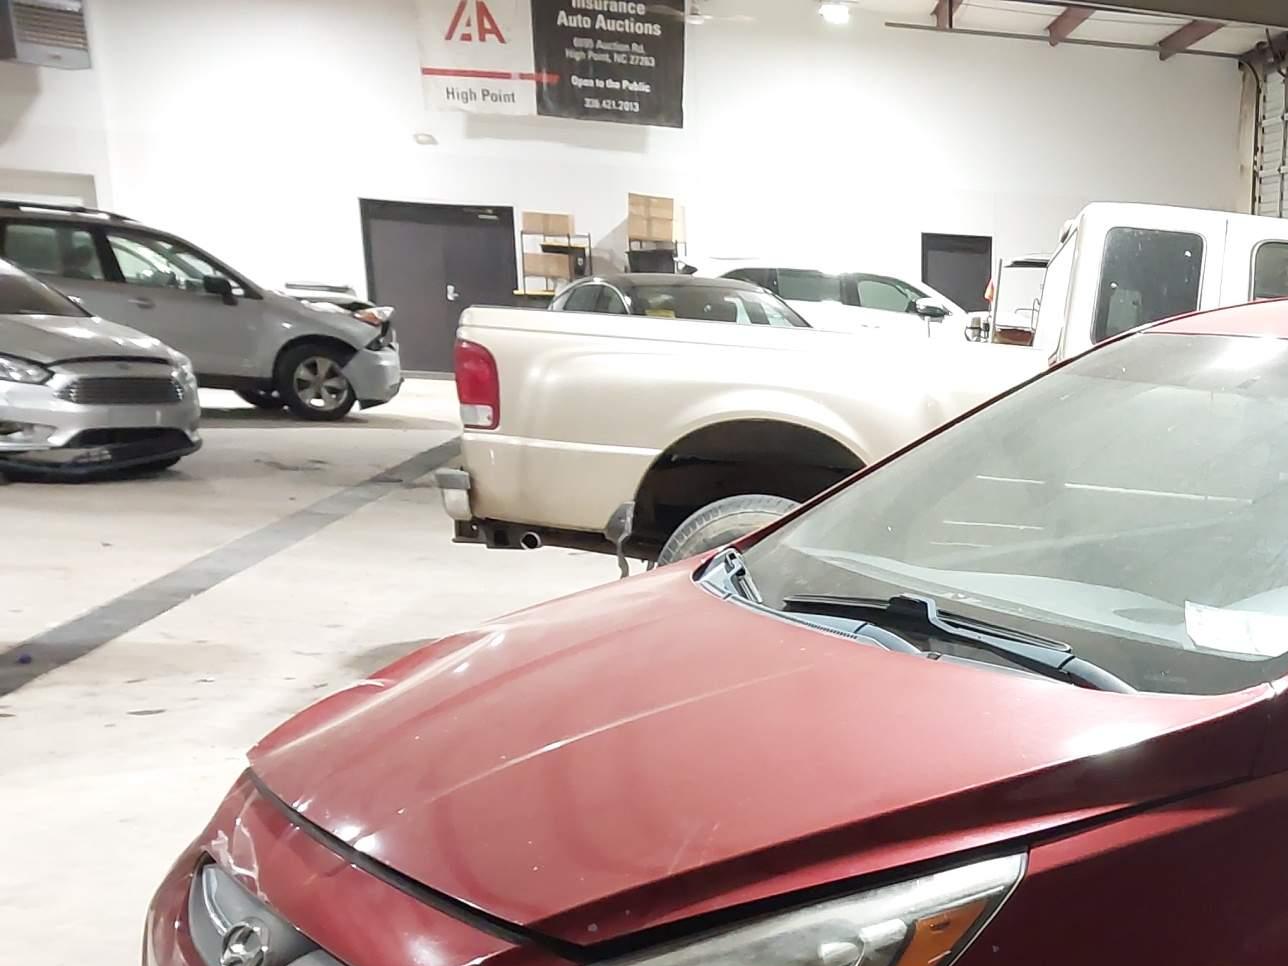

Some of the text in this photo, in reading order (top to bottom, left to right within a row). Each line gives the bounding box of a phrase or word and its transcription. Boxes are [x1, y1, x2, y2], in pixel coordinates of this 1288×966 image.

[571, 0, 646, 15] Insurance
[557, 10, 662, 36] Auto Auctions
[613, 53, 628, 65] NC
[571, 75, 652, 93] Open to the Public
[445, 87, 516, 105] High Point
